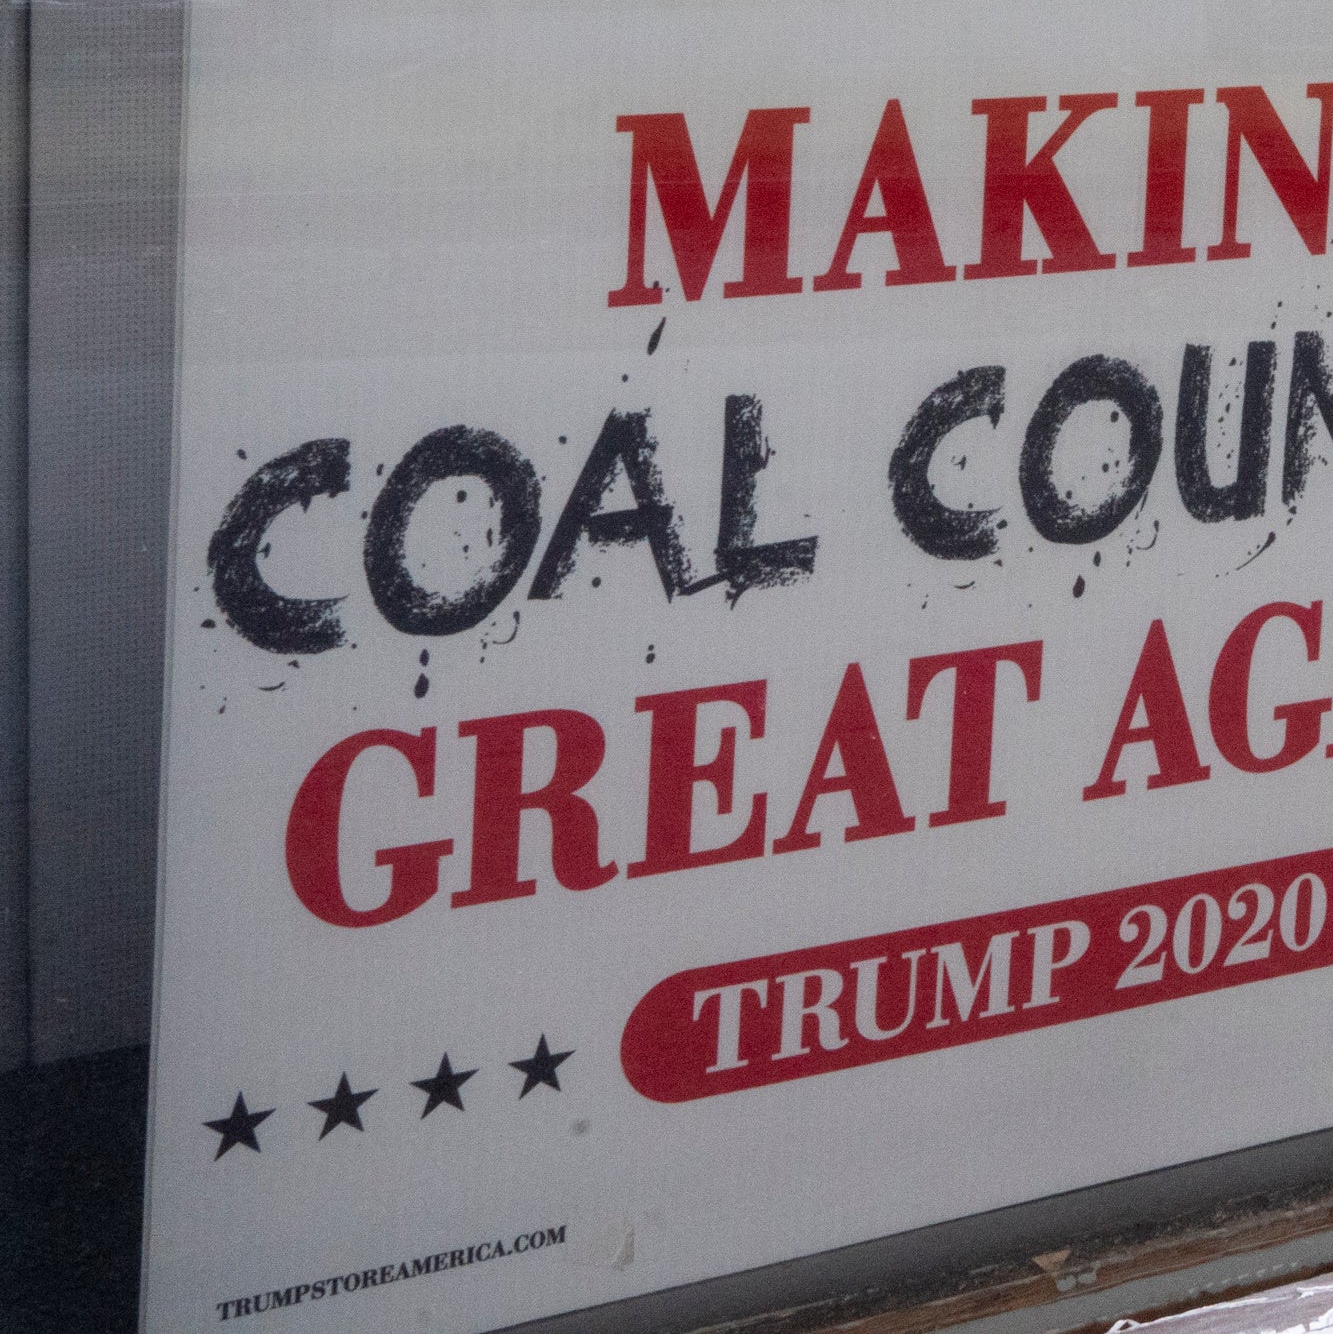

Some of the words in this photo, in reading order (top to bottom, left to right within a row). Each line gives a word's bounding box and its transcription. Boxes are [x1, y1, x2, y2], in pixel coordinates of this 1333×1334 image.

[206, 395, 818, 655] COAL
[286, 640, 1043, 929] GREAT
[694, 920, 1090, 1073] TRUMP
[1116, 872, 1328, 990] 2020
[215, 1224, 568, 1322] TRUMPSTOREAMERICA.COM
